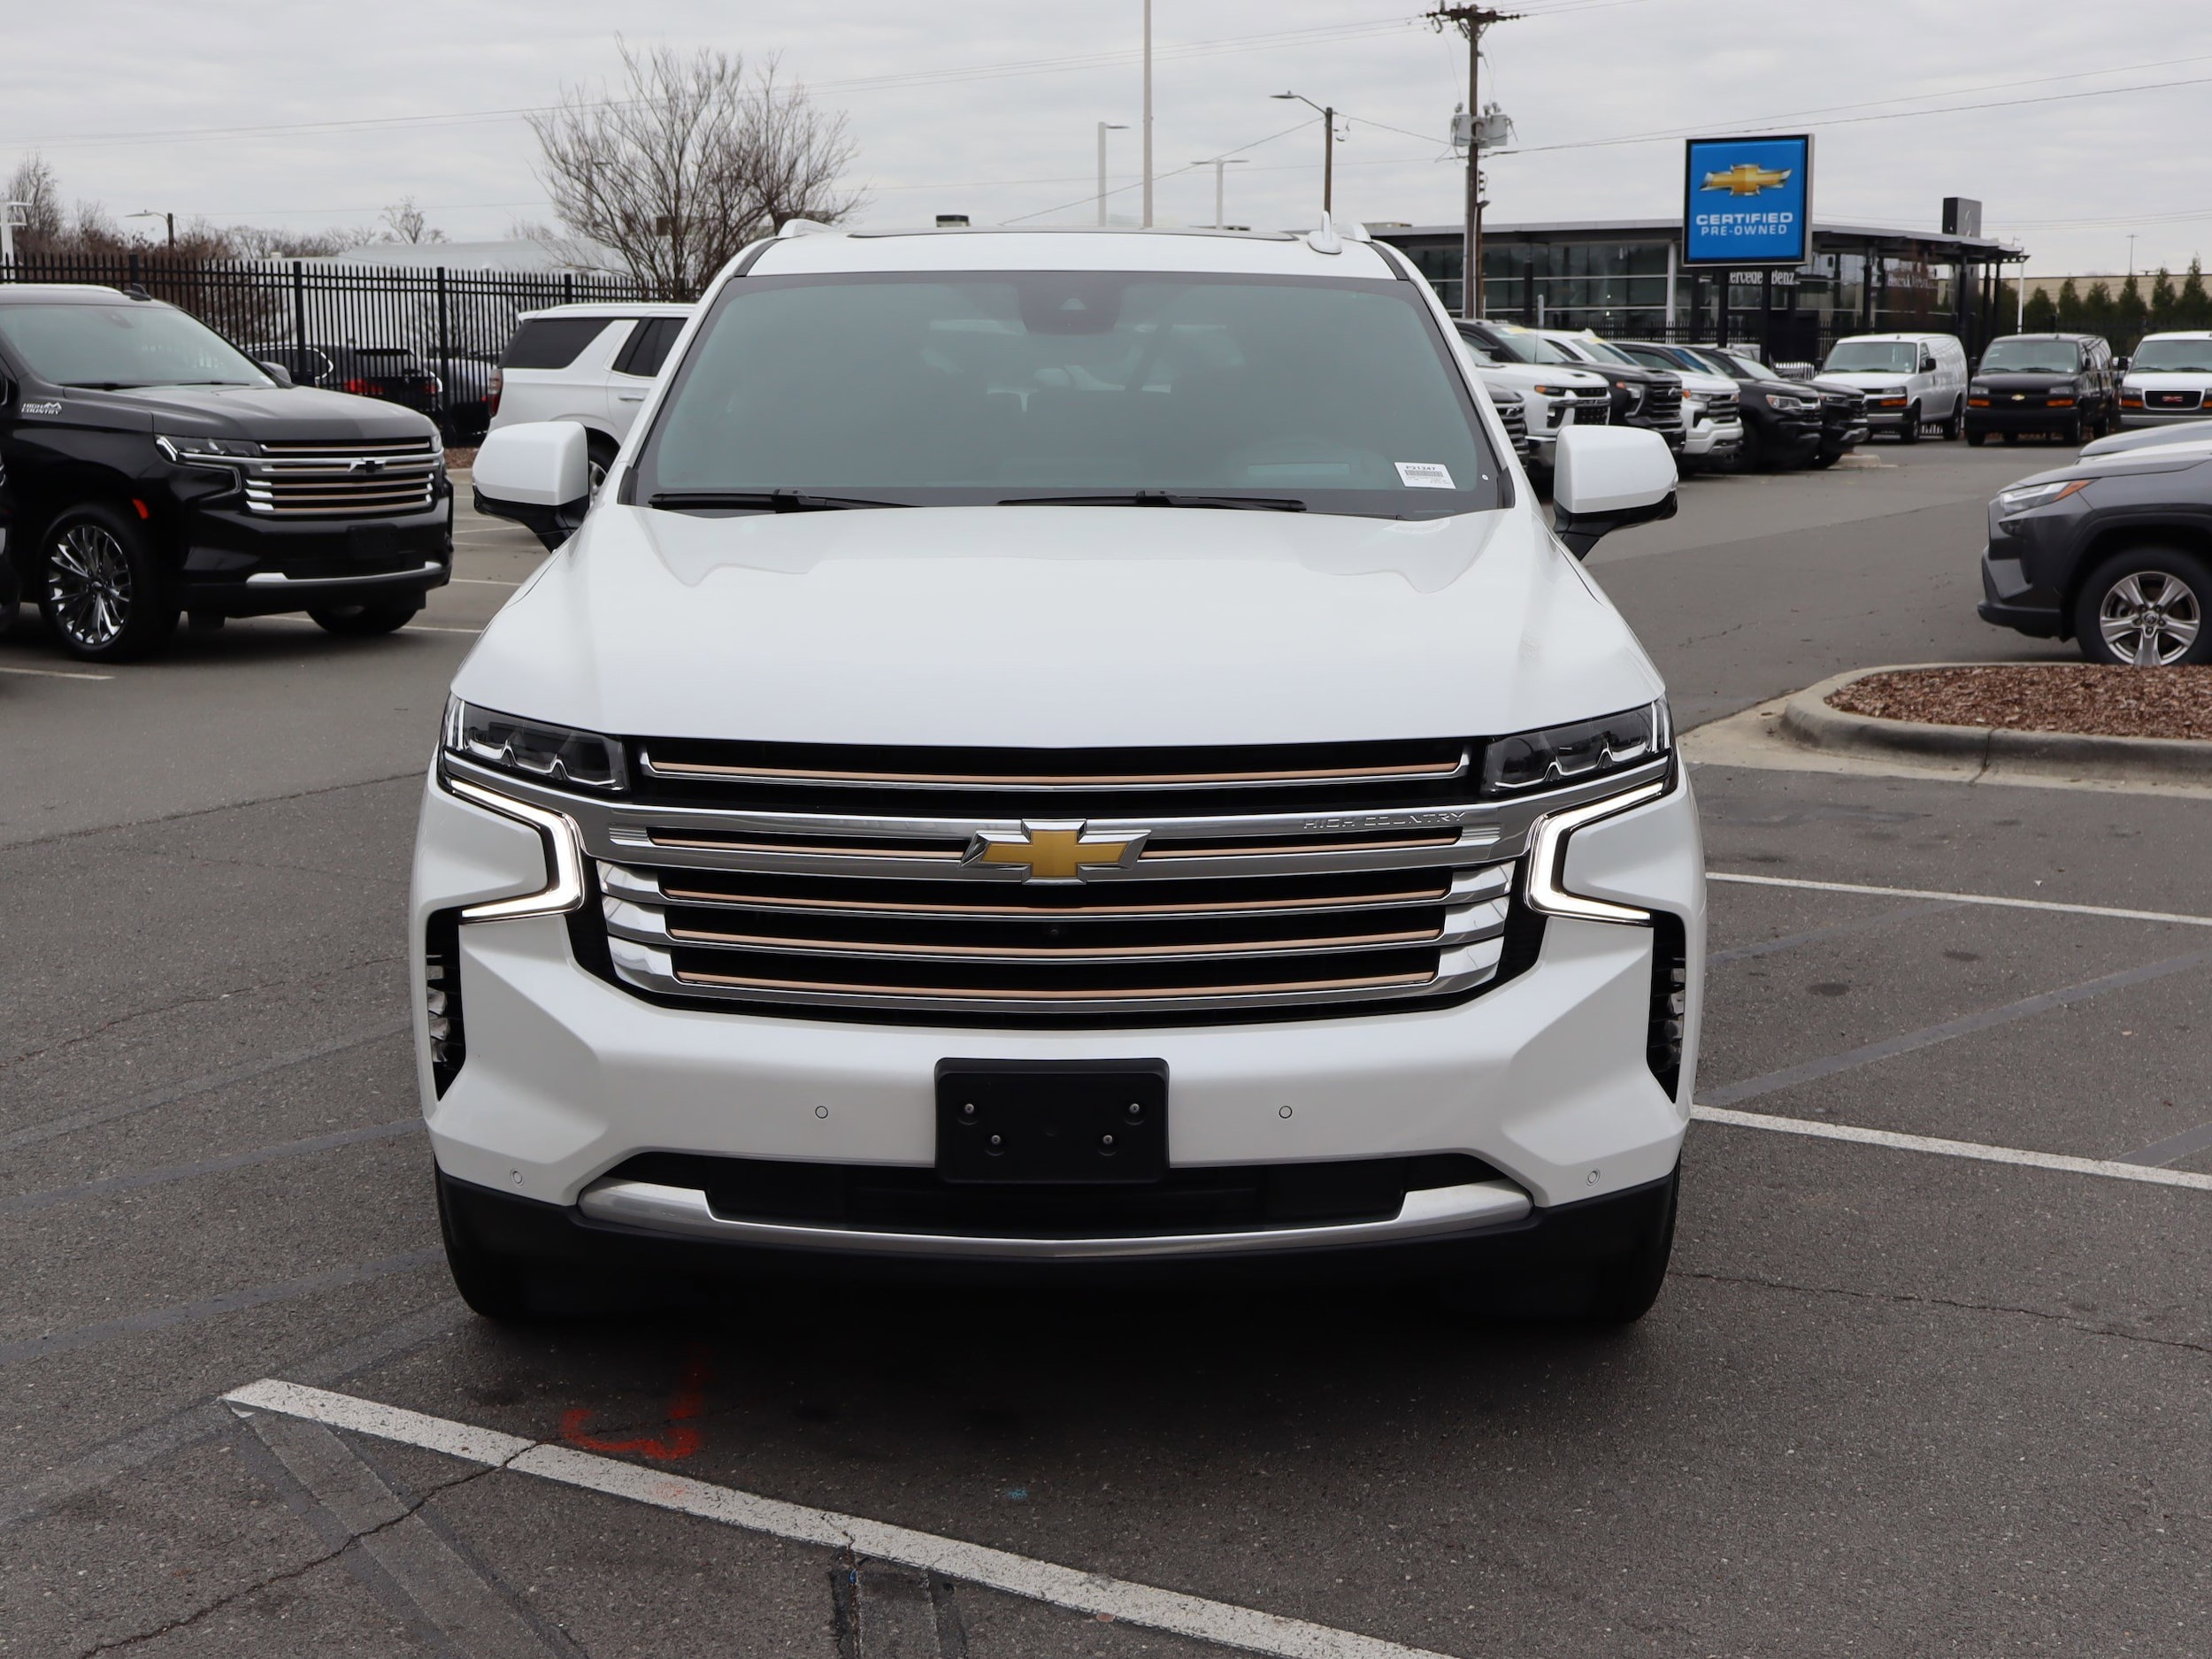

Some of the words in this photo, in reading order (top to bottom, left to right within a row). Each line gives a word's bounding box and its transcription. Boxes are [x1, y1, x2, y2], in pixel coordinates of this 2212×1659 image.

[1696, 212, 1793, 225] CERTIFIED
[1701, 224, 1787, 235] PRE-OWNED
[1302, 817, 1356, 828] HIGH
[1364, 811, 1465, 826] COUNTRY
